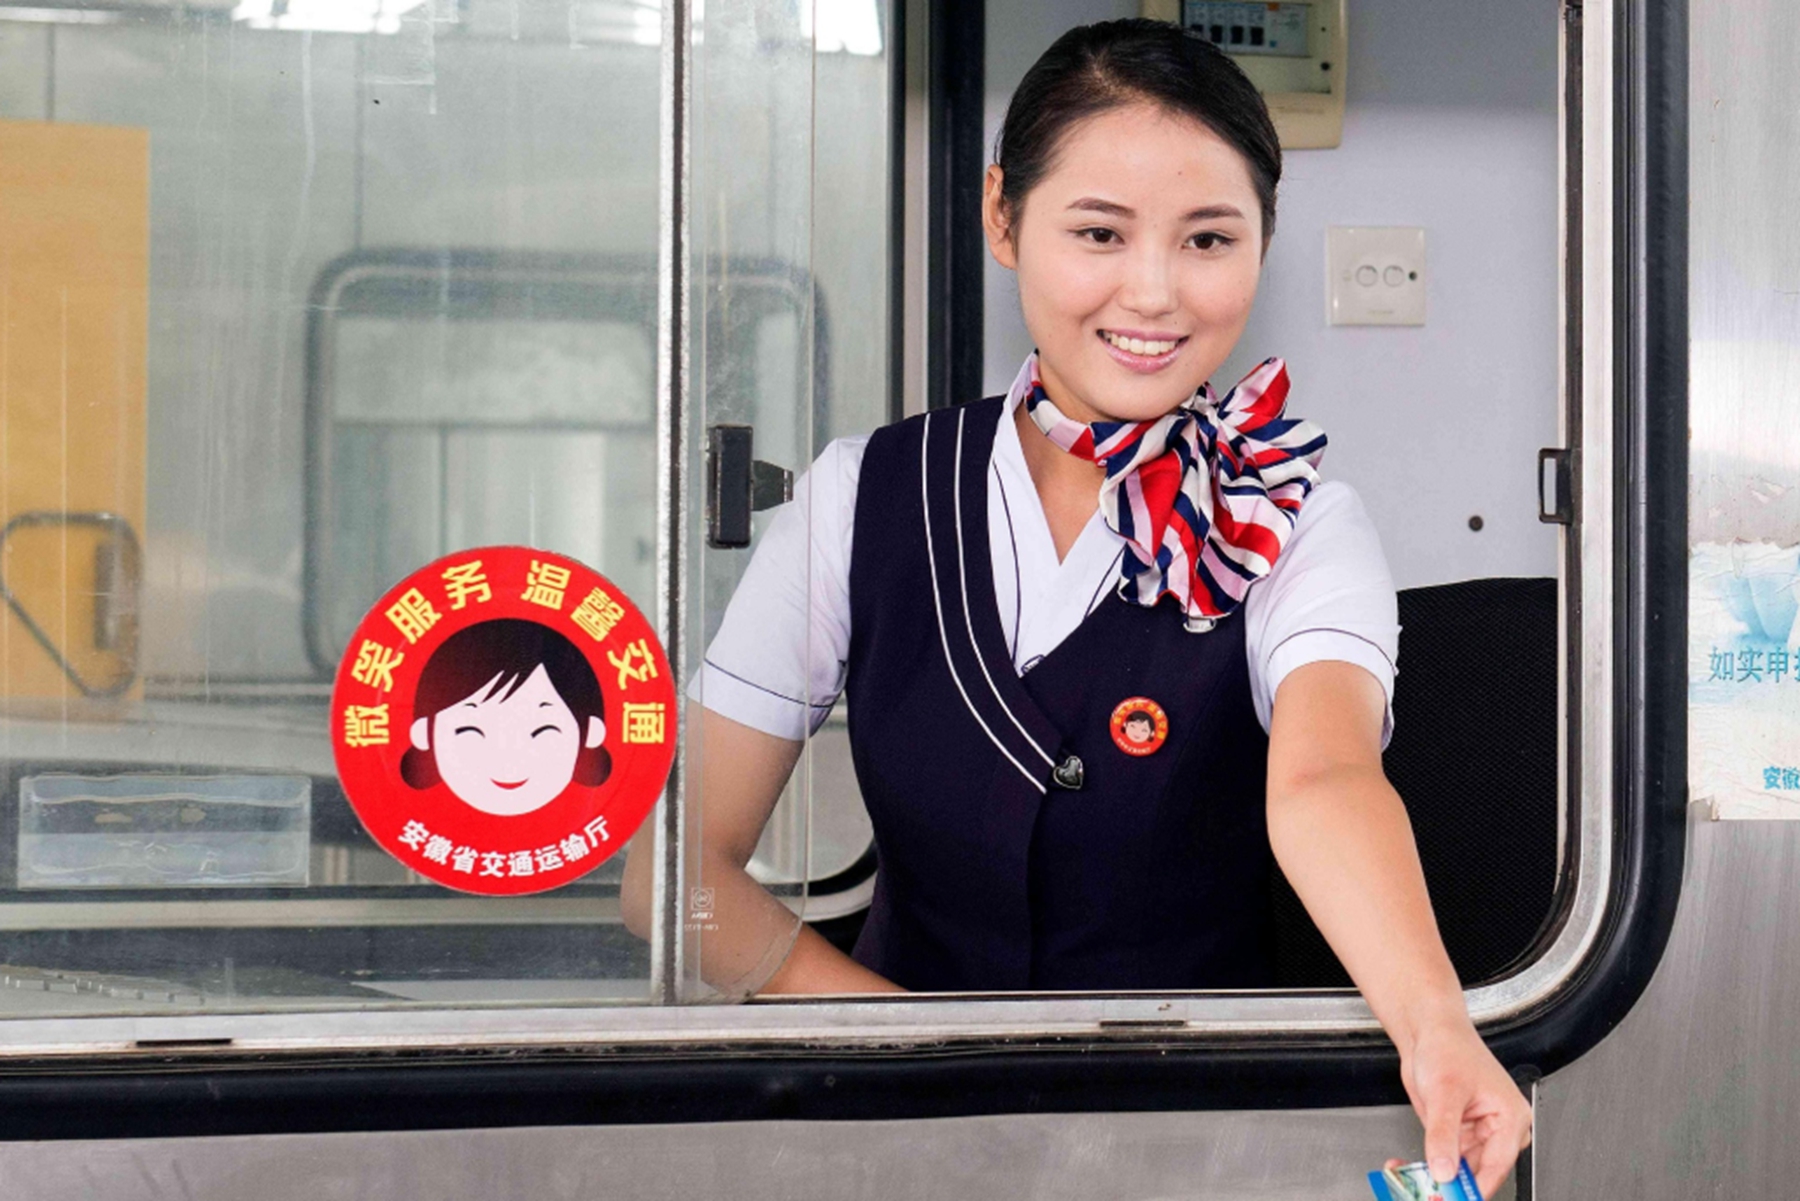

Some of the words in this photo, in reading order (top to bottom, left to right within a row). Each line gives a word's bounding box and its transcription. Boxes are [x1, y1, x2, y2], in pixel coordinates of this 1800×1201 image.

[344, 560, 492, 748] 微笑服务
[520, 560, 665, 744] 温馨交通
[1708, 646, 1800, 683] 如实申
[398, 816, 611, 878] 安徽省交通运输厅
